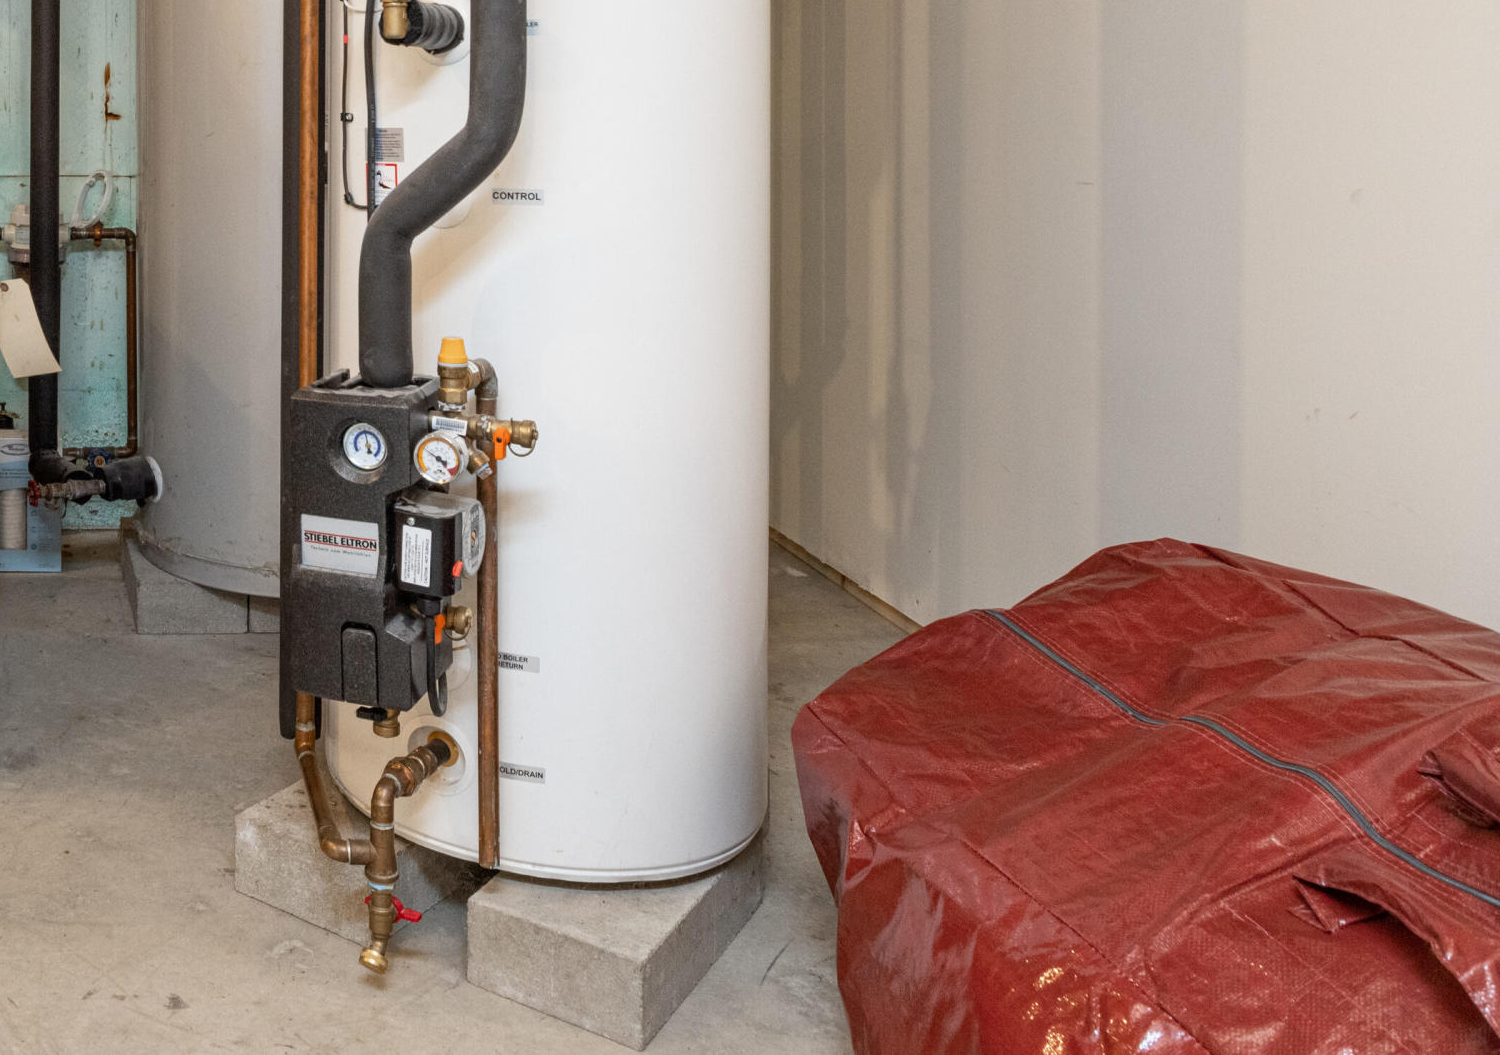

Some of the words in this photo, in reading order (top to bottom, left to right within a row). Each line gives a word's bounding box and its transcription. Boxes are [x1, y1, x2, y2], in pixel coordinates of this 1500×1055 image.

[492, 191, 541, 201] CONTROL
[304, 532, 339, 545] STIEBEL
[341, 538, 377, 549] ELTRON
[503, 654, 528, 663] BOILER
[500, 766, 543, 778] OLD/DRAIN
